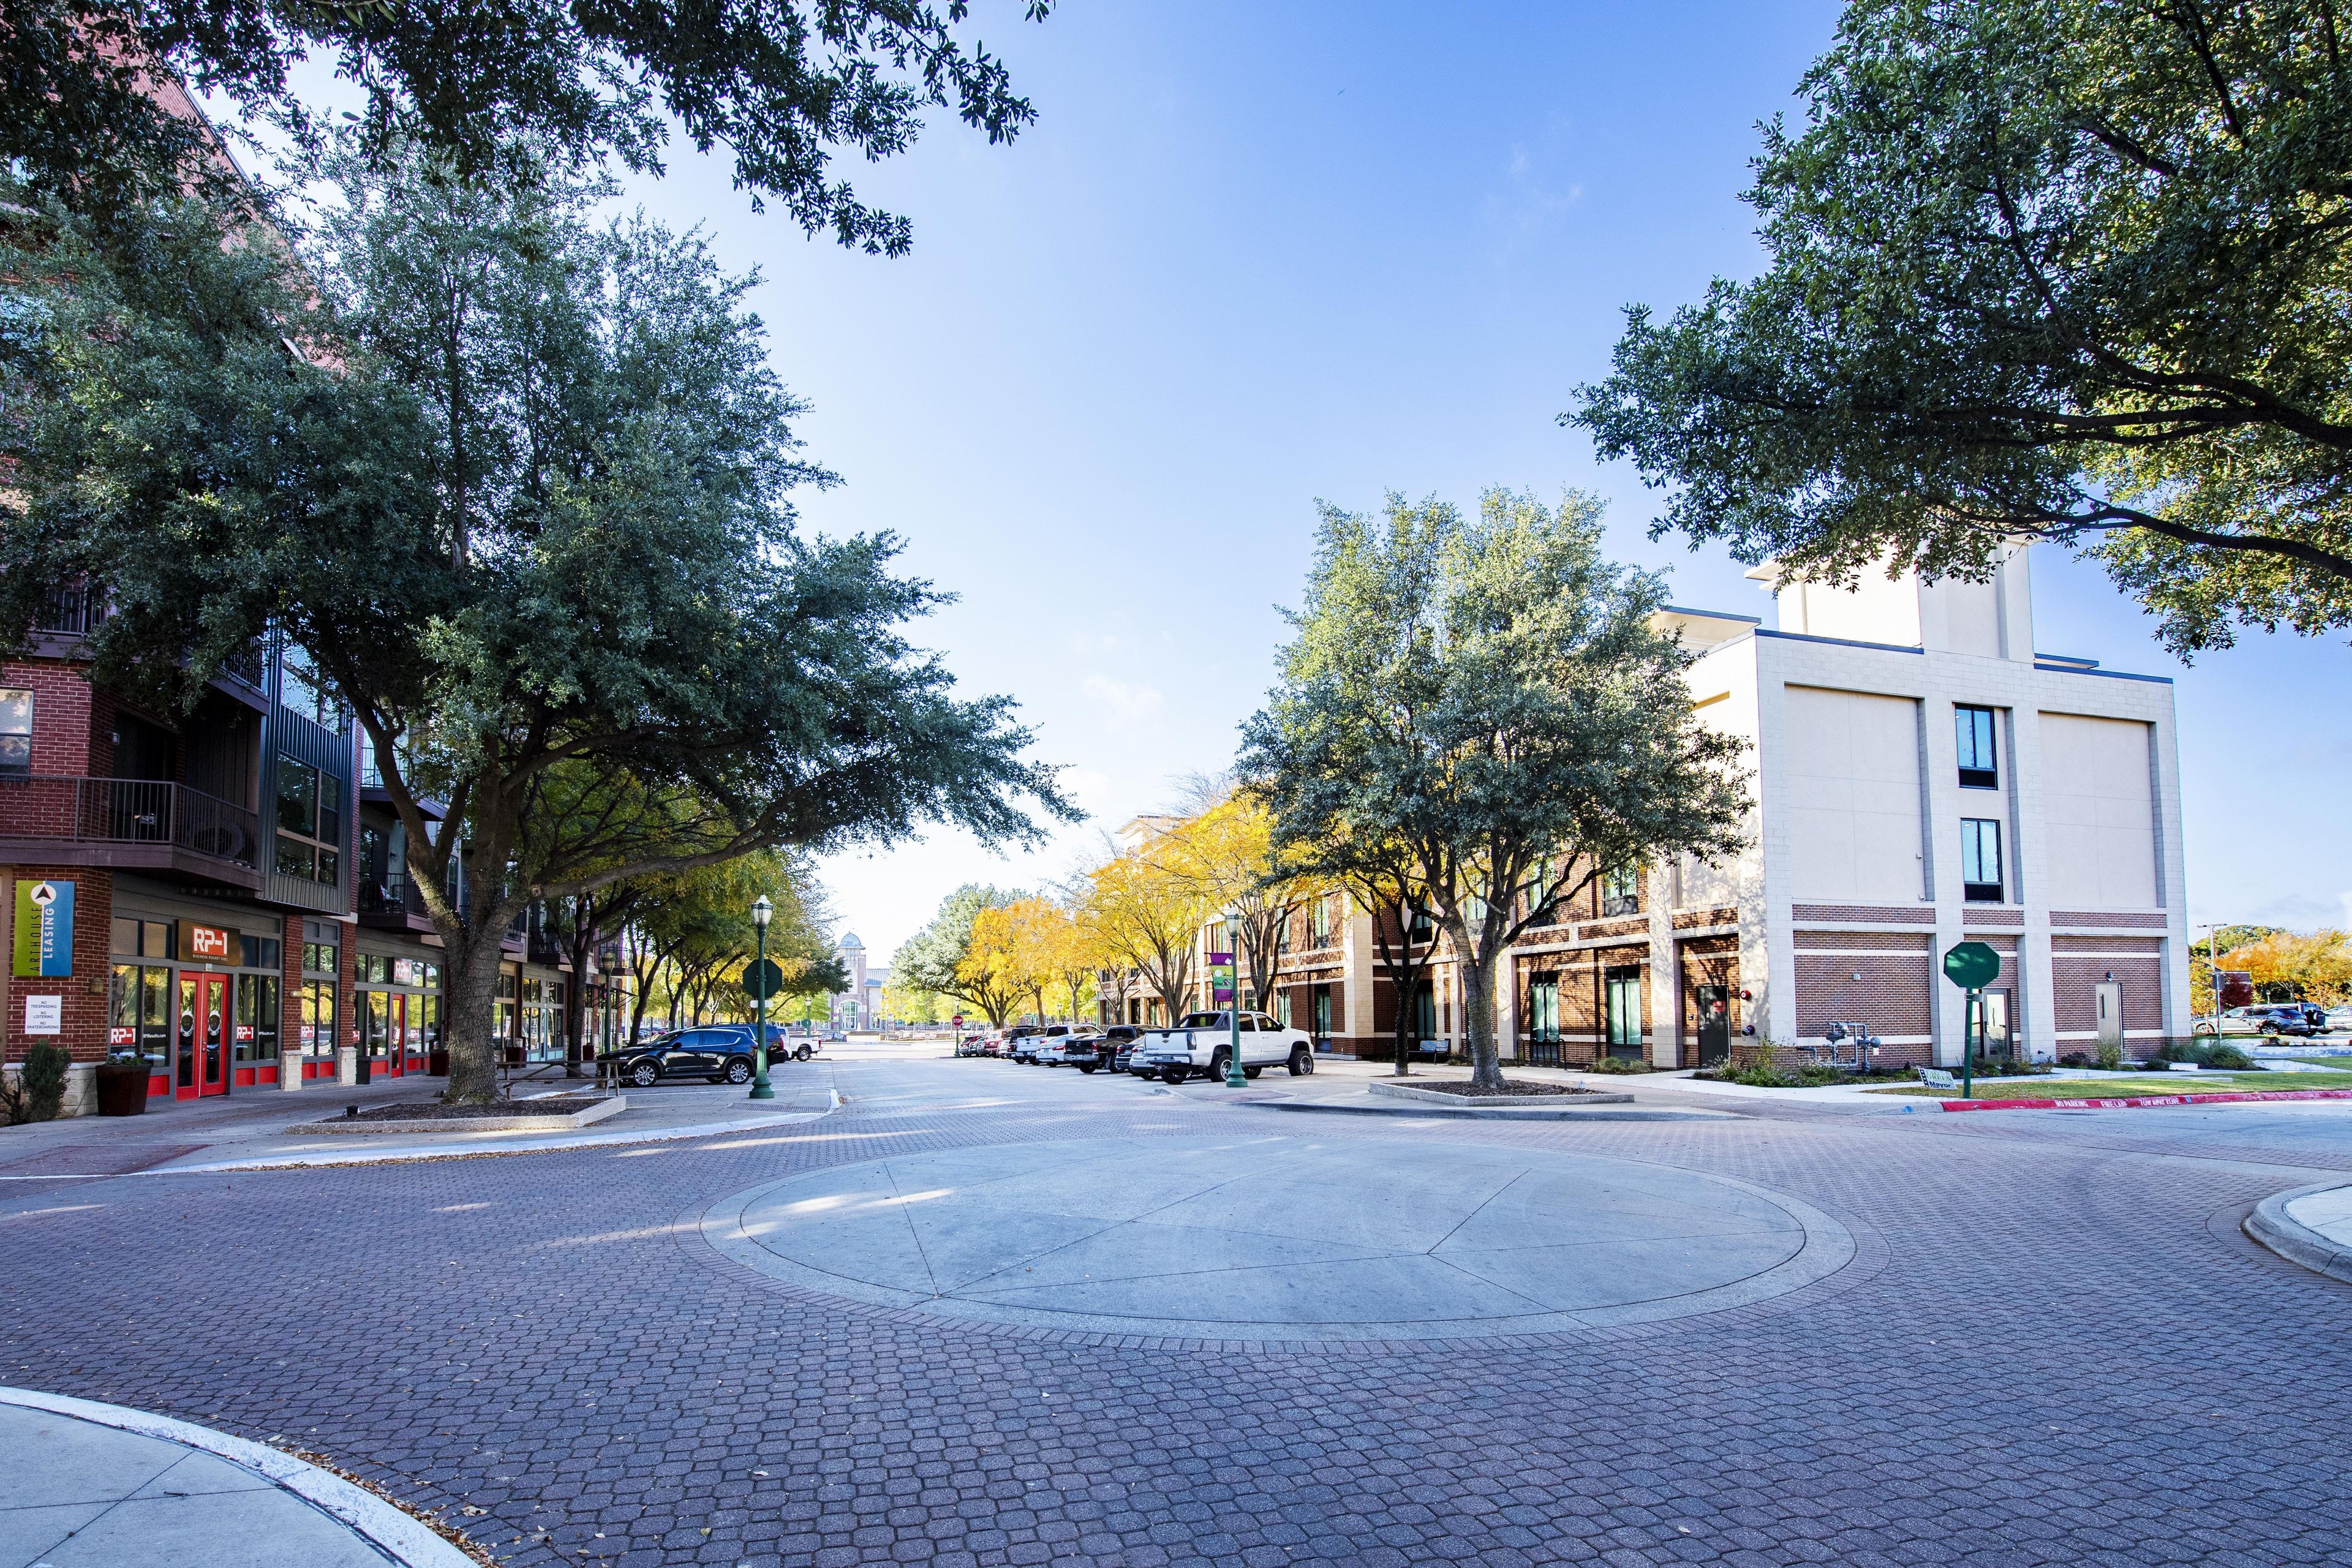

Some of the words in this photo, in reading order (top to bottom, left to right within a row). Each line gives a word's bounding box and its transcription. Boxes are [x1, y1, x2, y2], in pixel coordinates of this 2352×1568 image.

[29, 908, 42, 971] ARTHOUSE
[43, 908, 55, 959] LEASING
[194, 928, 227, 954] RP-1
[395, 961, 412, 979] RP-1
[111, 1028, 136, 1043] RP-1
[236, 1027, 254, 1039] RP-1
[301, 1026, 315, 1037] RP-1
